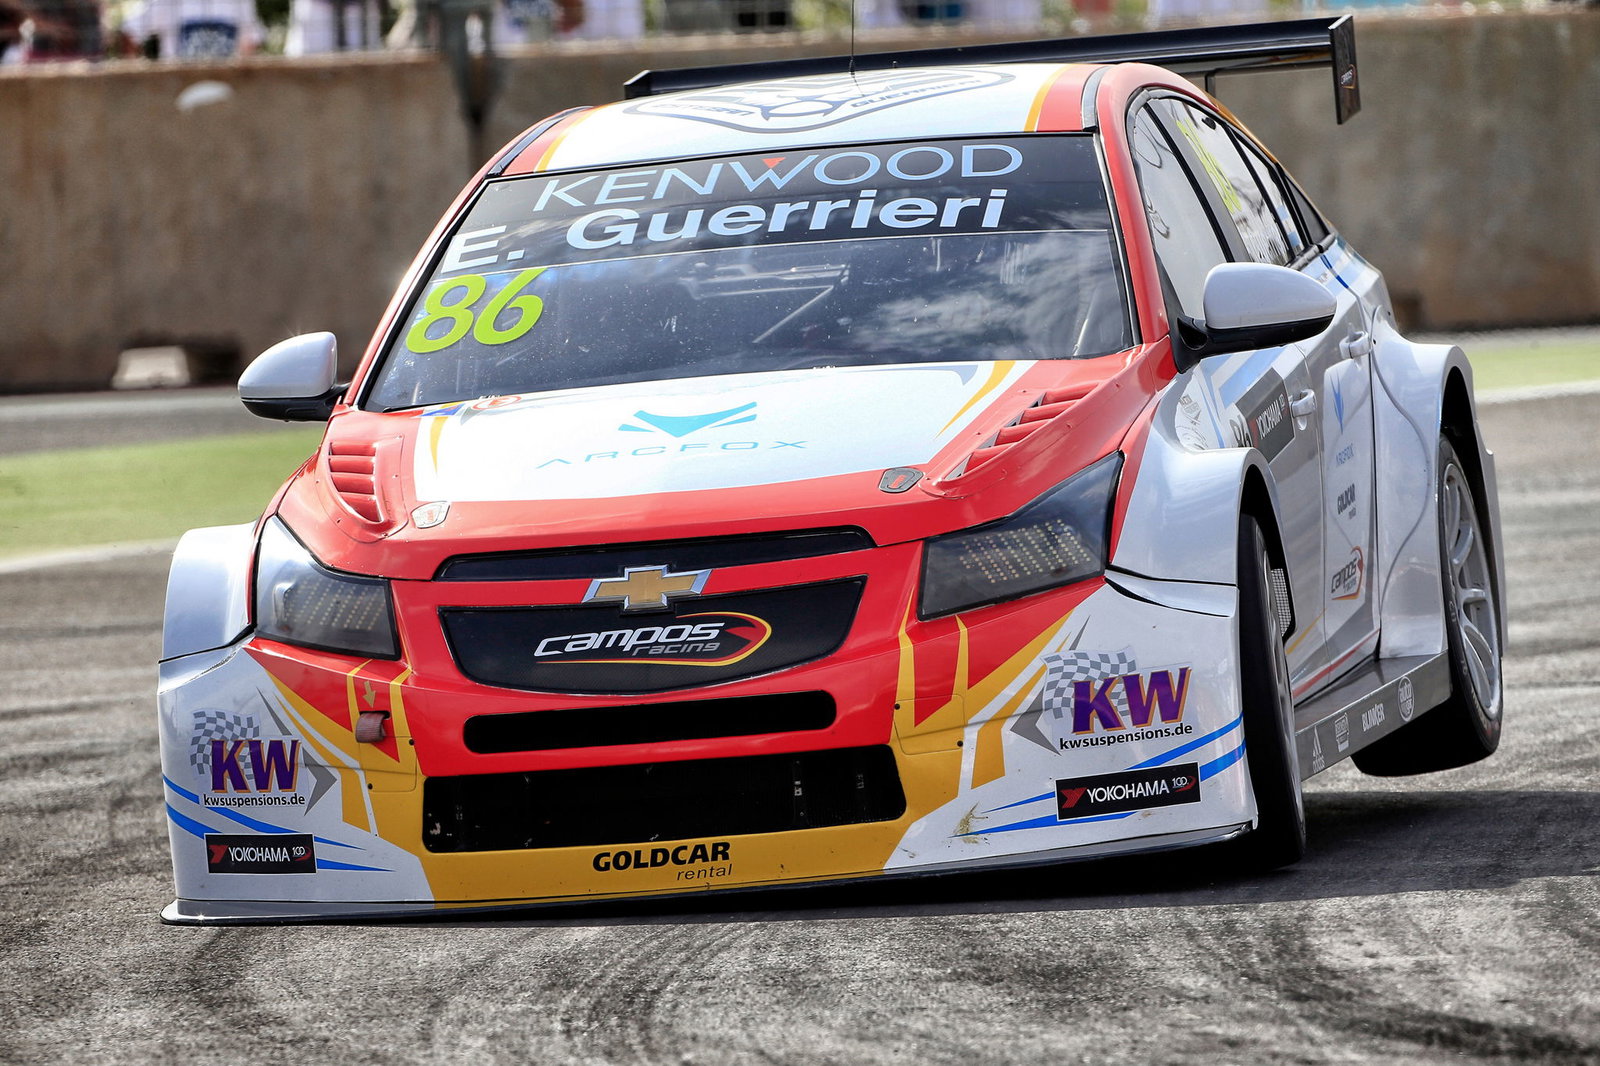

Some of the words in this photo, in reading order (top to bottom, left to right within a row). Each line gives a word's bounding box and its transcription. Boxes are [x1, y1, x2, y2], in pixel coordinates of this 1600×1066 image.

[533, 144, 1023, 212] KENWOOD
[441, 225, 525, 273] E.
[566, 189, 1008, 250] Guerrieri
[406, 267, 549, 353] 86
[536, 440, 809, 470] ARCFOX
[632, 642, 721, 657] racing
[1072, 666, 1192, 734] KW
[1059, 722, 1193, 750] kwsuspensions.de
[211, 739, 302, 793] KW
[203, 793, 306, 808] kwsuspensions.de
[1087, 779, 1170, 803] YOKOHAMA
[1171, 775, 1188, 789] 100
[228, 846, 290, 862] YOKOHAMA
[592, 841, 731, 872] GOLDCAR
[676, 863, 733, 881] rental
